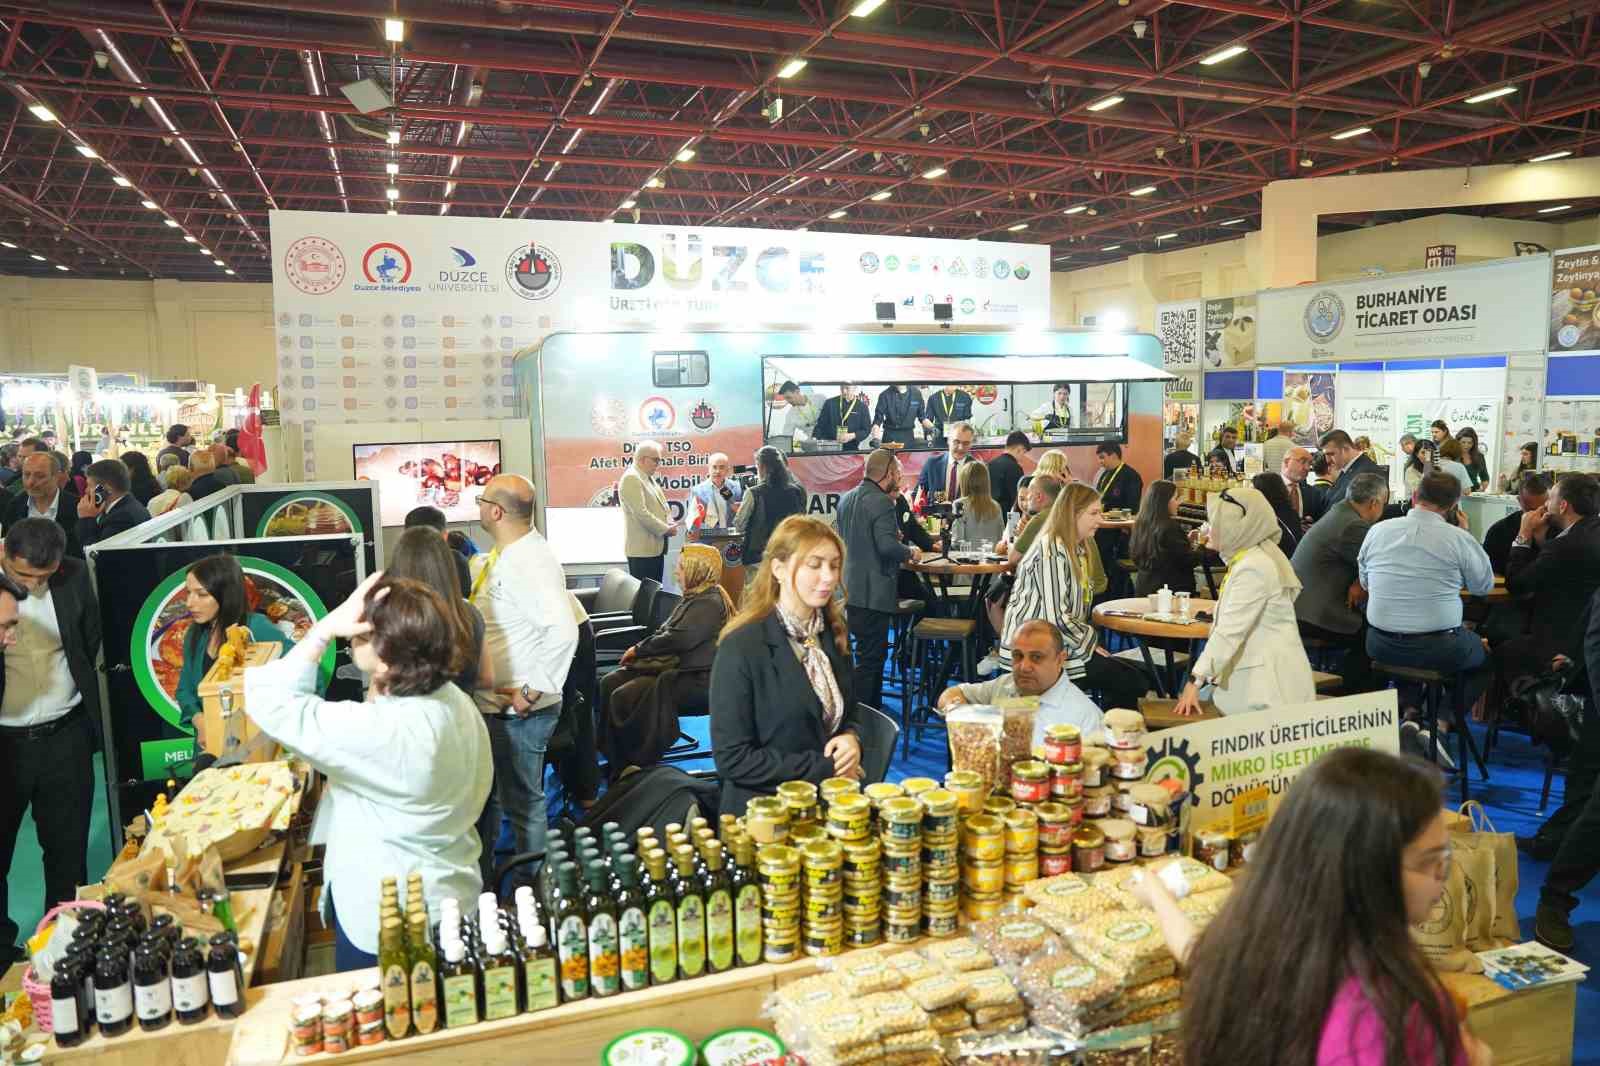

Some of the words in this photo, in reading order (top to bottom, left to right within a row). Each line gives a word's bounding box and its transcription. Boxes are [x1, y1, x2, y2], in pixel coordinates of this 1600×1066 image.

[1428, 246, 1442, 257] WC
[1557, 256, 1589, 269] Zeytin
[1591, 255, 1599, 265] &
[1356, 285, 1447, 310] BURHANİYE
[1356, 309, 1418, 329] TİCARET
[1422, 304, 1477, 324] ODASI
[666, 441, 692, 452] TSO
[590, 458, 618, 469] Afet
[688, 455, 709, 465] Biri
[655, 475, 701, 490] Mobil
[1211, 731, 1265, 757] FINDIK
[1270, 710, 1393, 745] ÜRETİCİLERİNİN
[164, 750, 193, 763] MEL
[1211, 756, 1265, 783] MİKRO
